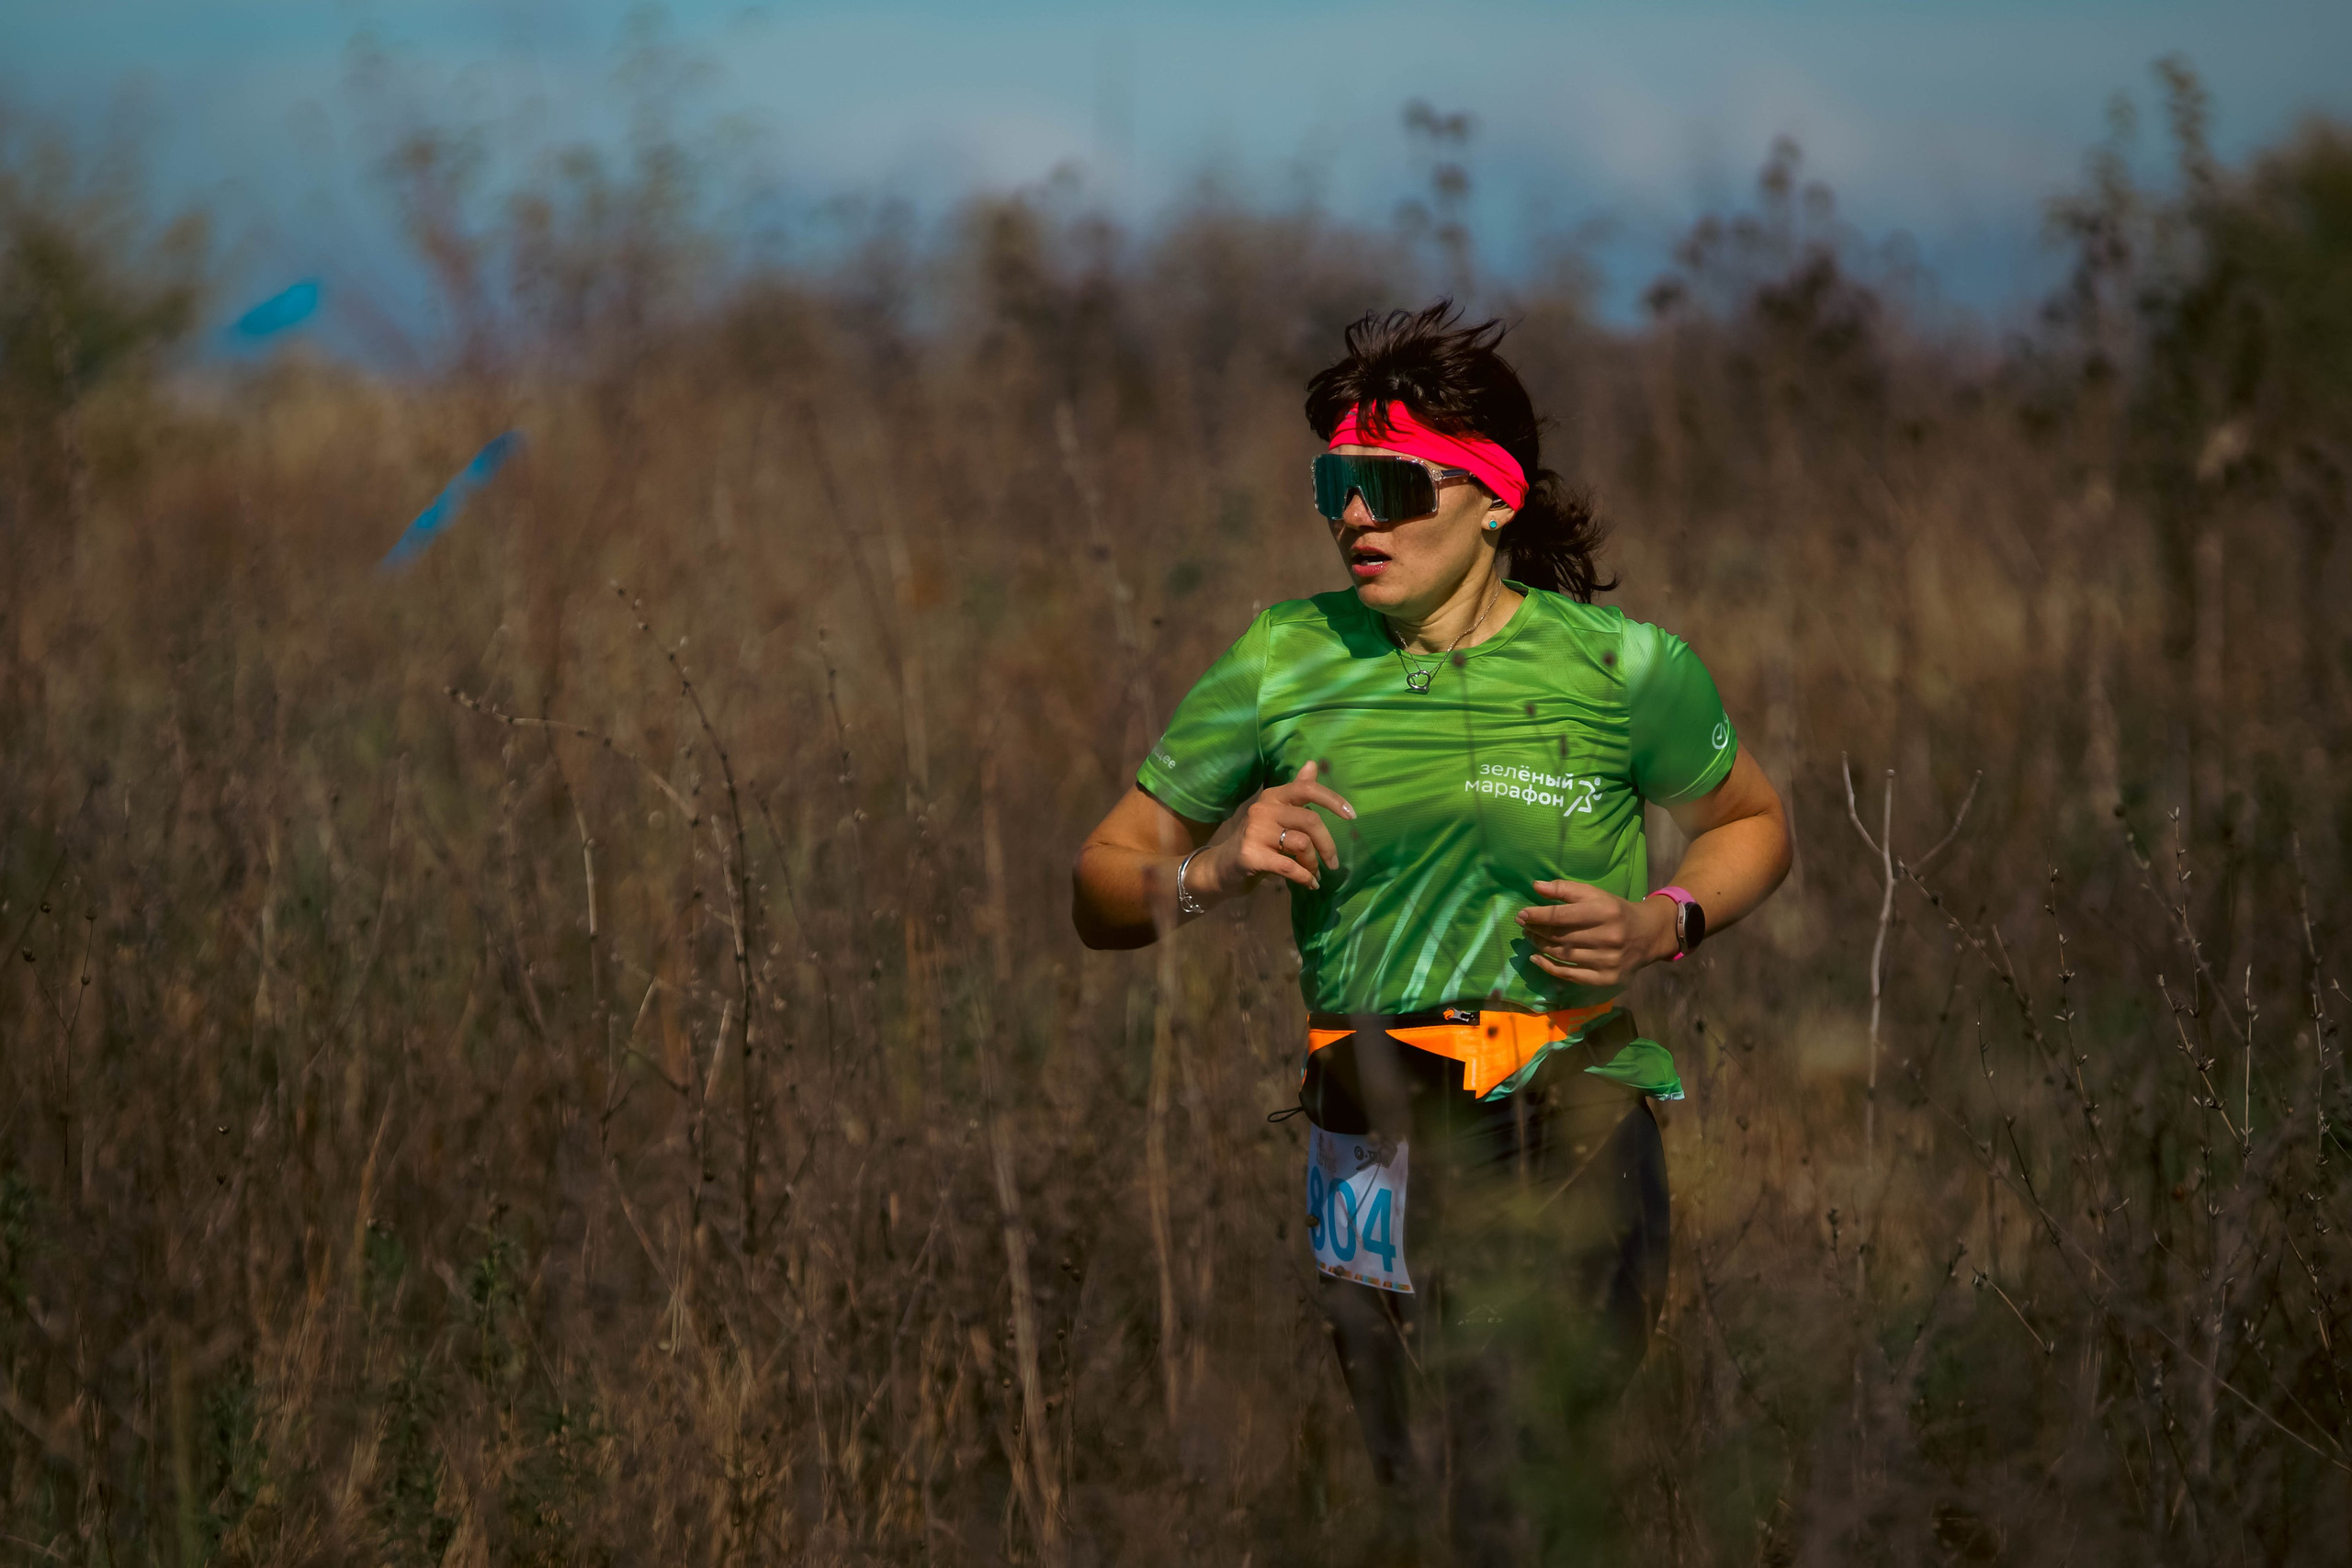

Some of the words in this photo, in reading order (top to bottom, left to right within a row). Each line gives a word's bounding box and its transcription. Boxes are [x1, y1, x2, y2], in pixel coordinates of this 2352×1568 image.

[1480, 764, 1574, 790] зелёный
[1465, 780, 1565, 807] марафон
[1309, 1166, 1396, 1273] 804
